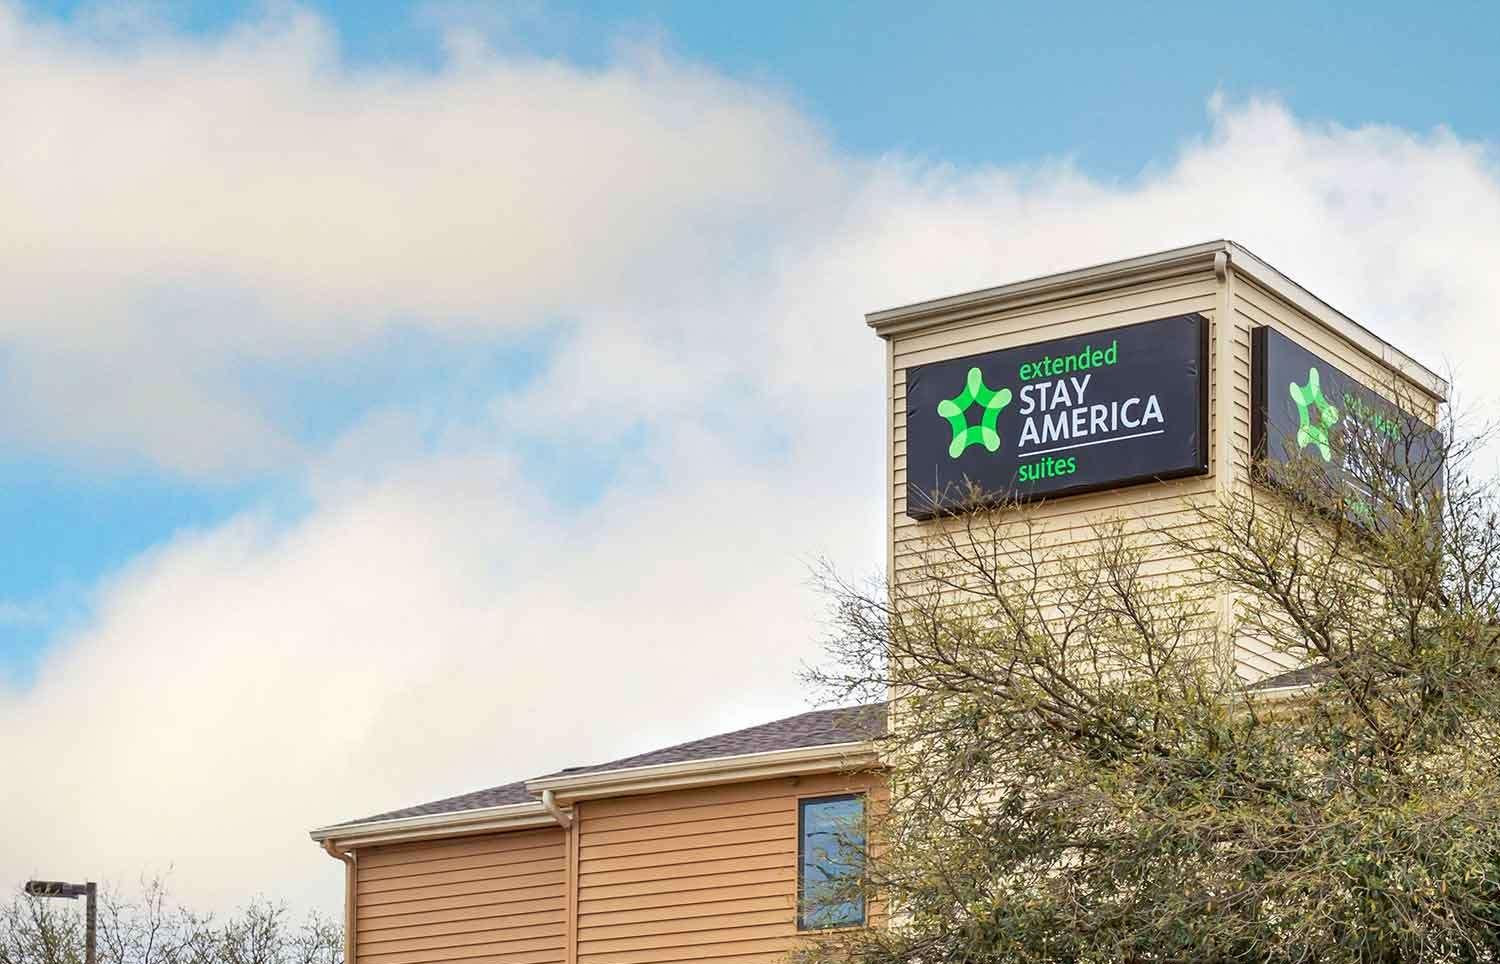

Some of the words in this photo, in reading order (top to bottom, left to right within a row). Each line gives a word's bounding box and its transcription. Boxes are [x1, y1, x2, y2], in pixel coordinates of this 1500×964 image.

[1019, 340, 1117, 380] extended
[1019, 374, 1091, 415] STAY
[1018, 395, 1164, 447] AMERICA
[1018, 457, 1077, 482] suites
